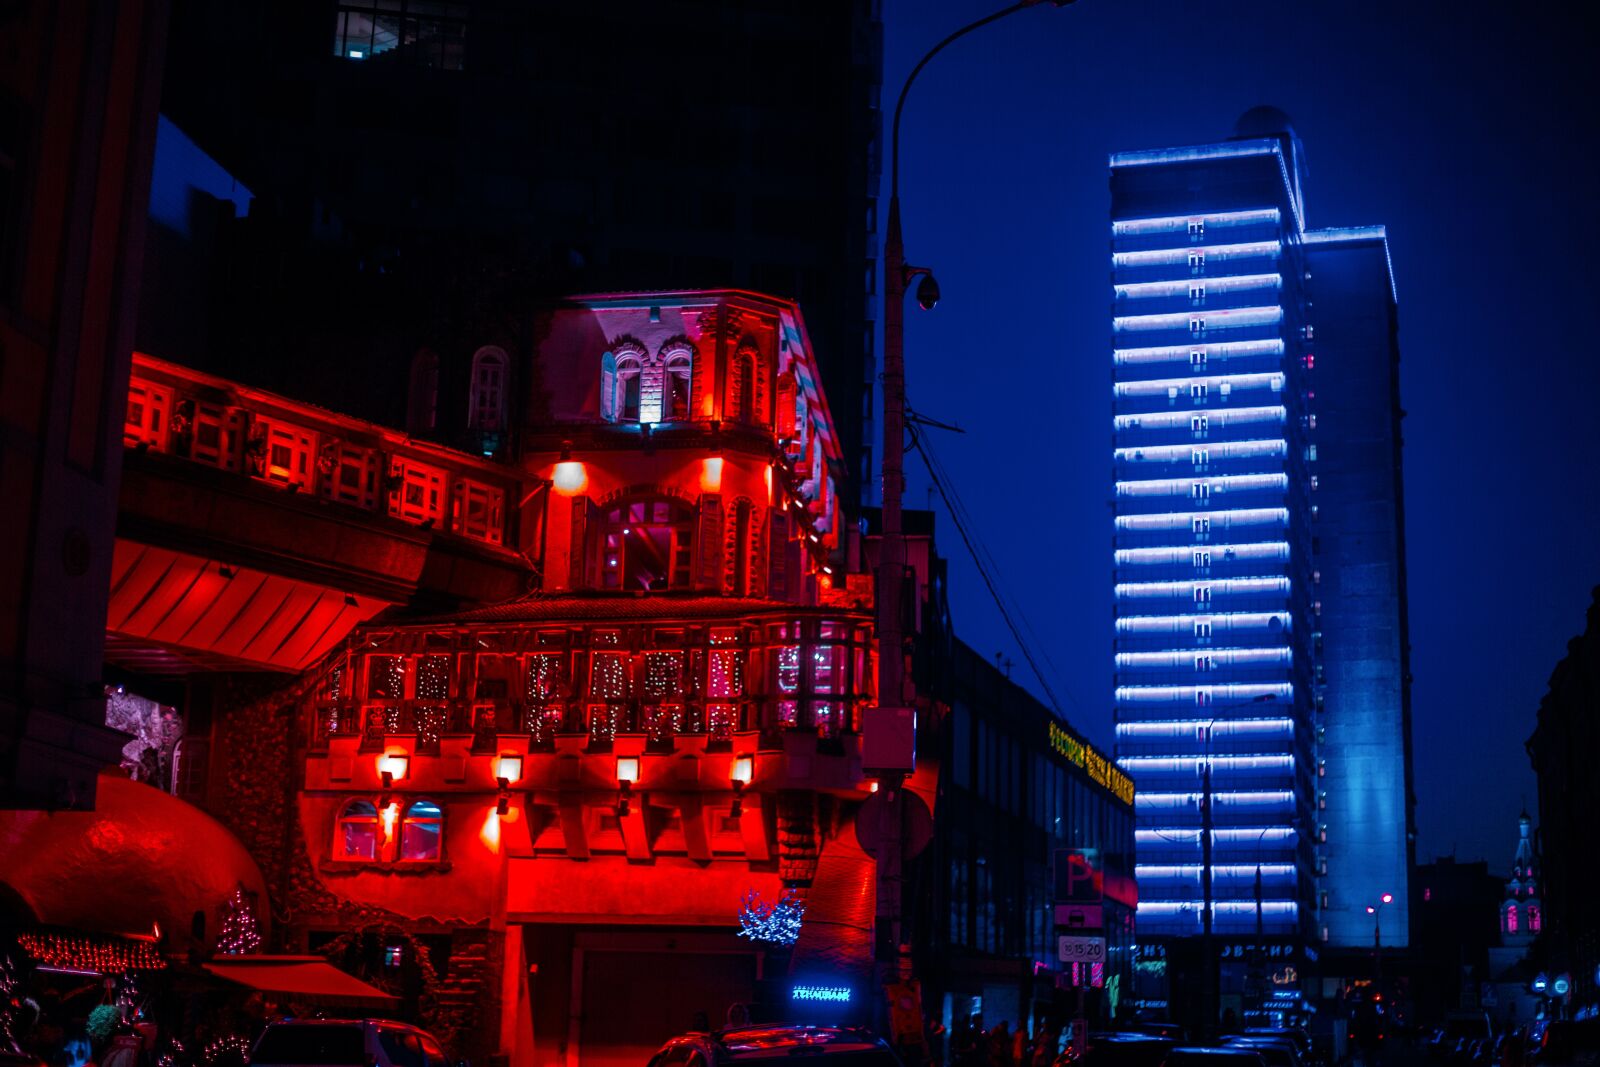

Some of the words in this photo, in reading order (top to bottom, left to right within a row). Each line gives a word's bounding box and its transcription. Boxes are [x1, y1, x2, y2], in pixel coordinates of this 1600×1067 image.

[1066, 854, 1094, 896] P
[1074, 943, 1084, 954] 15
[1086, 944, 1101, 956] 20
